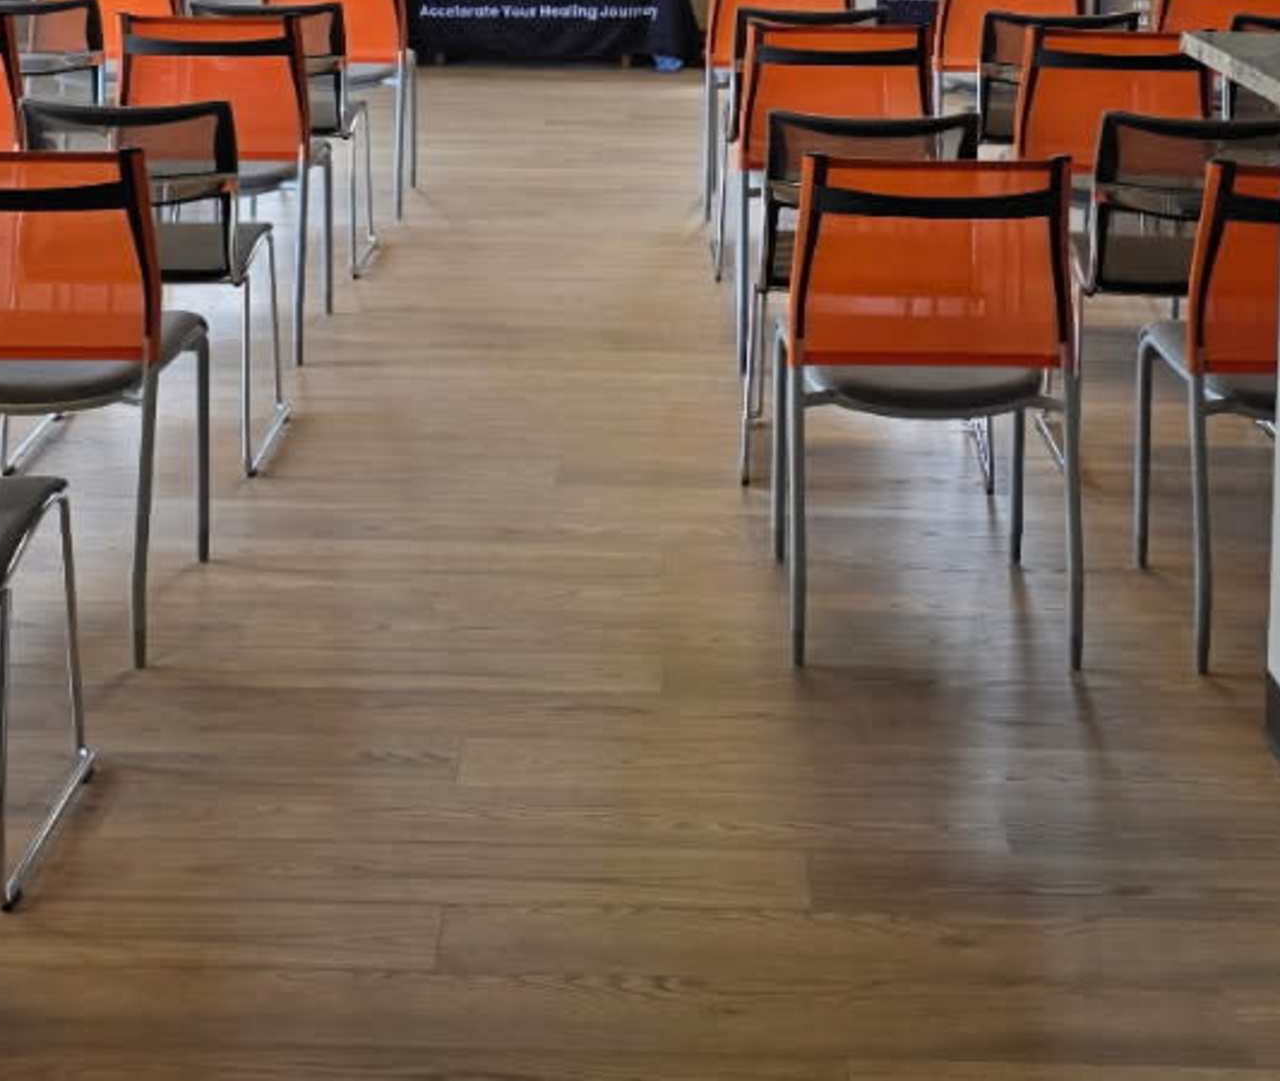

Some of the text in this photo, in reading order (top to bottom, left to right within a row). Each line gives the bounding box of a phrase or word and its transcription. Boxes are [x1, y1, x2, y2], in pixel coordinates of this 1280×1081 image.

[419, 4, 659, 21] Accelerate Your Healing Journey
